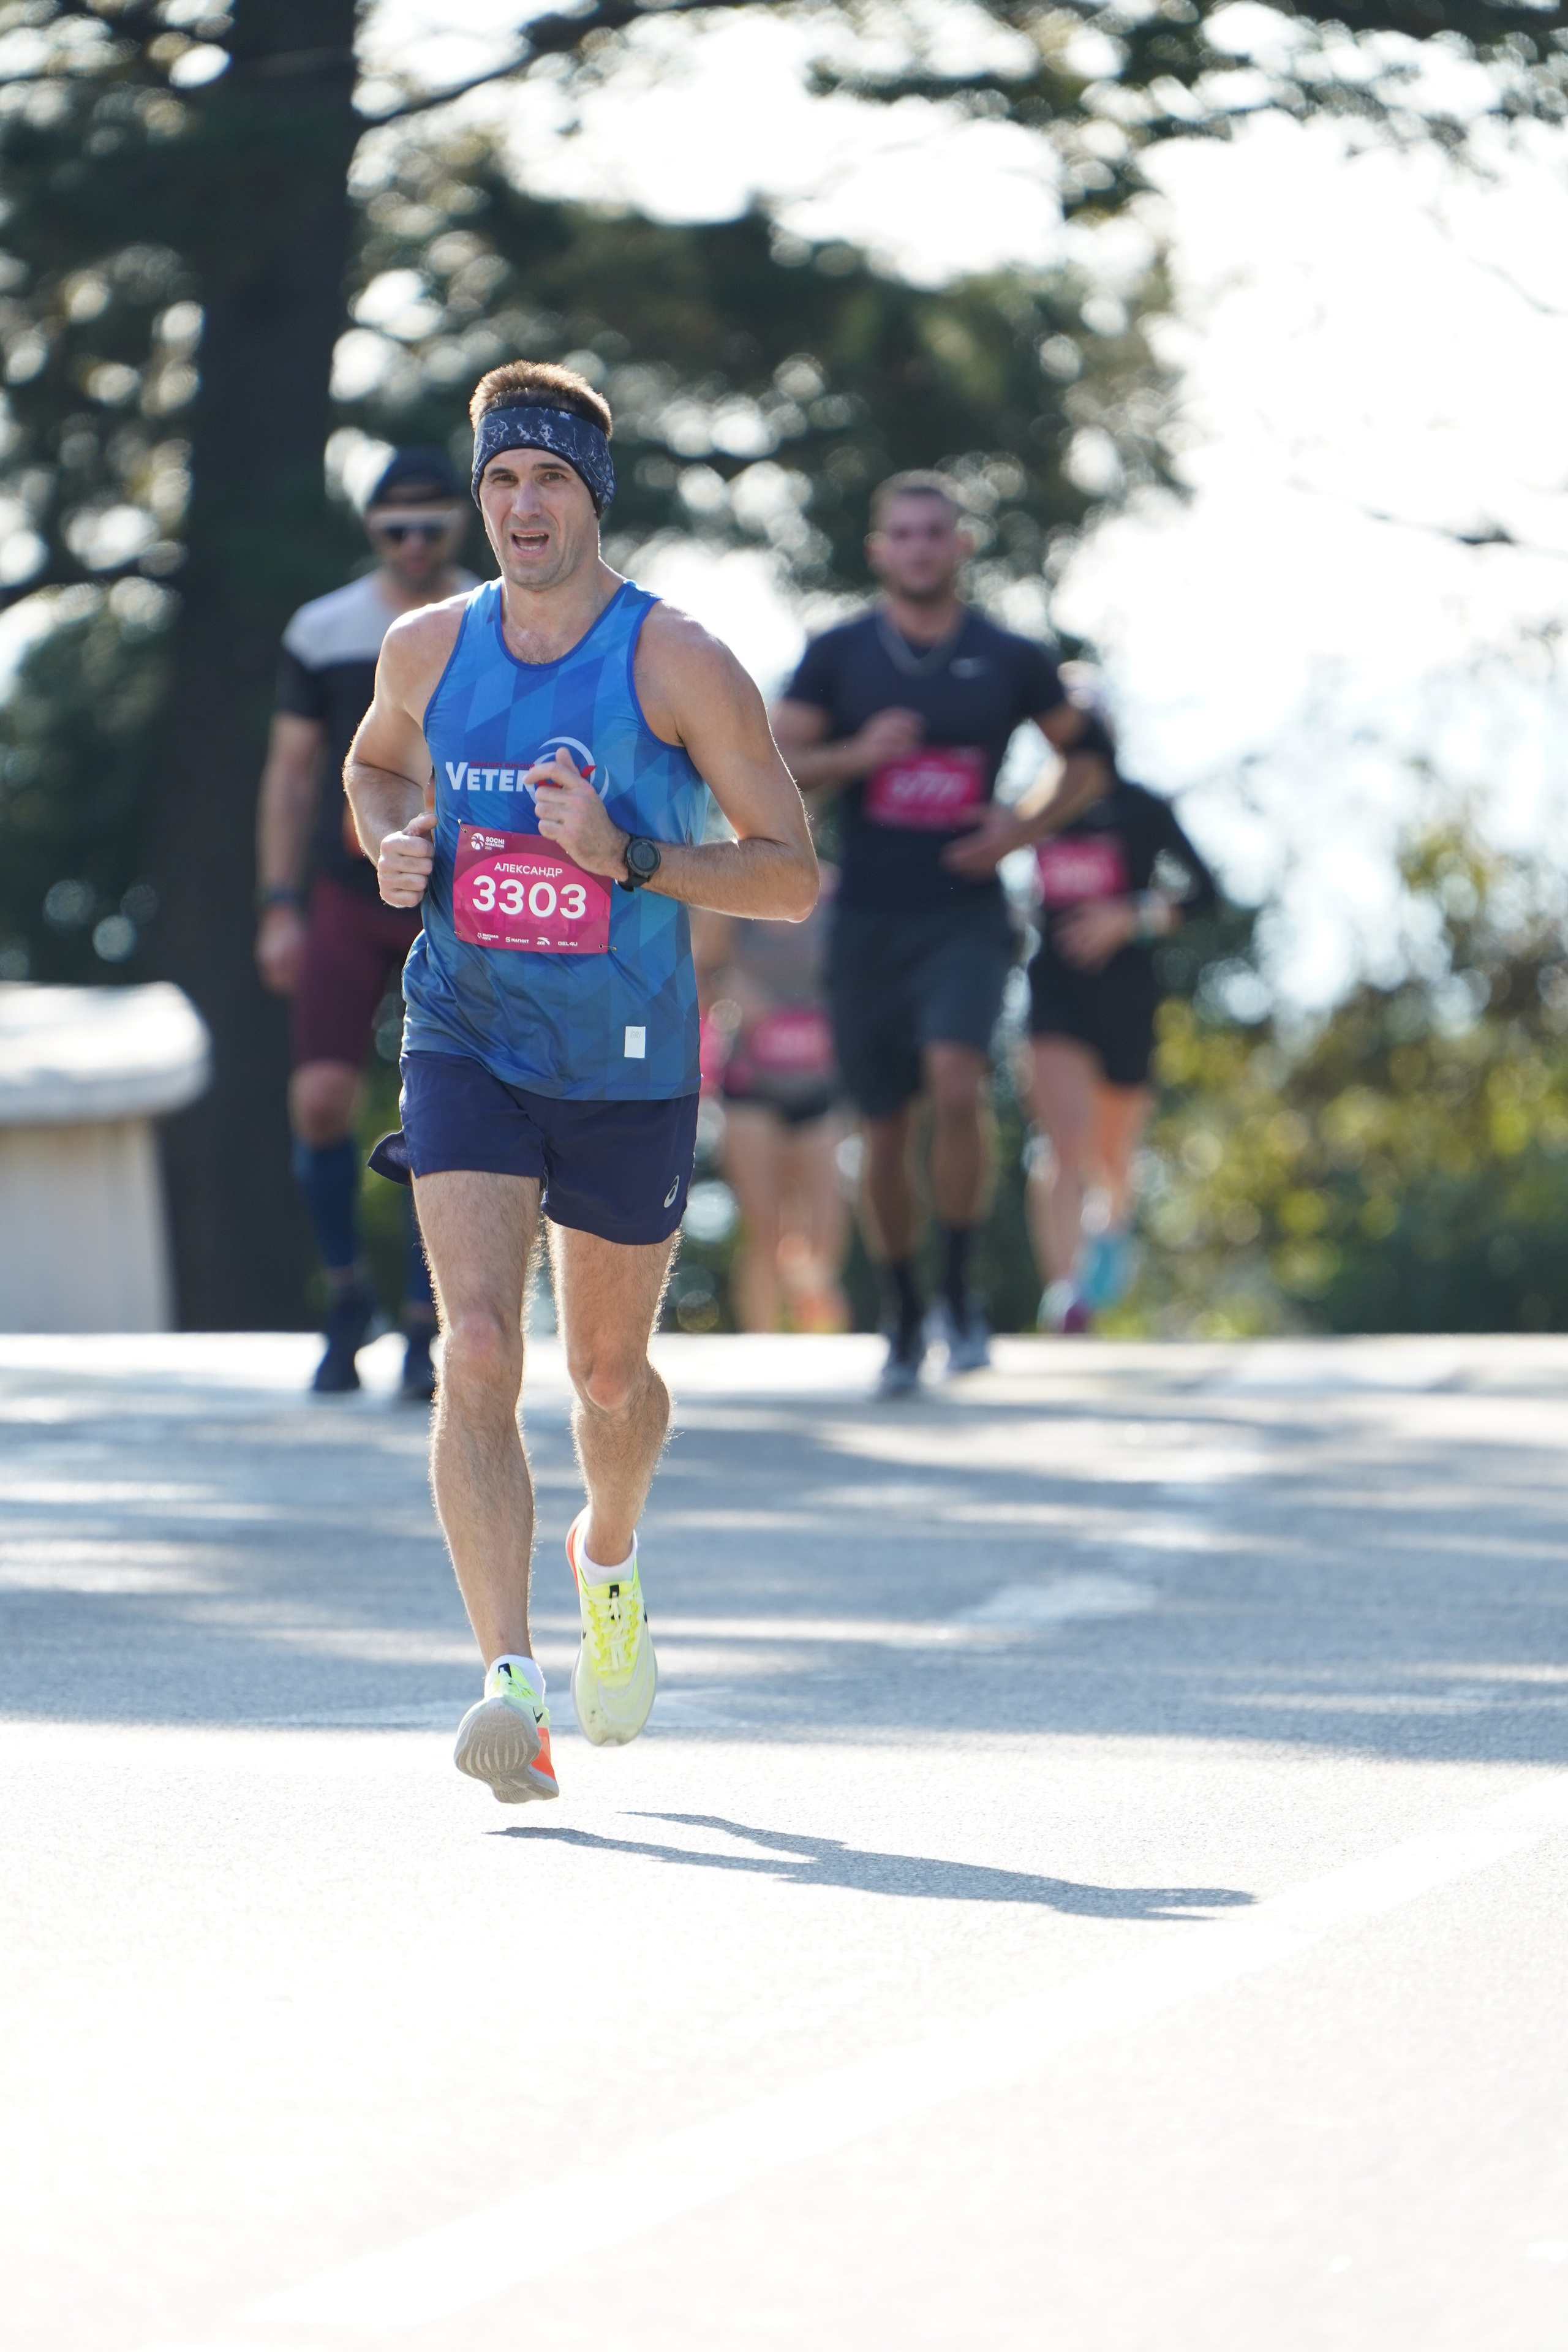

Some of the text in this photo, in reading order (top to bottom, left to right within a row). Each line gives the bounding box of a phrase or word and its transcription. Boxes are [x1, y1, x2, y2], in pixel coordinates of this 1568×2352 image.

[485, 836, 505, 845] SOCHI
[494, 862, 563, 878] АЛЕКСАНДР
[472, 875, 587, 919] 3303
